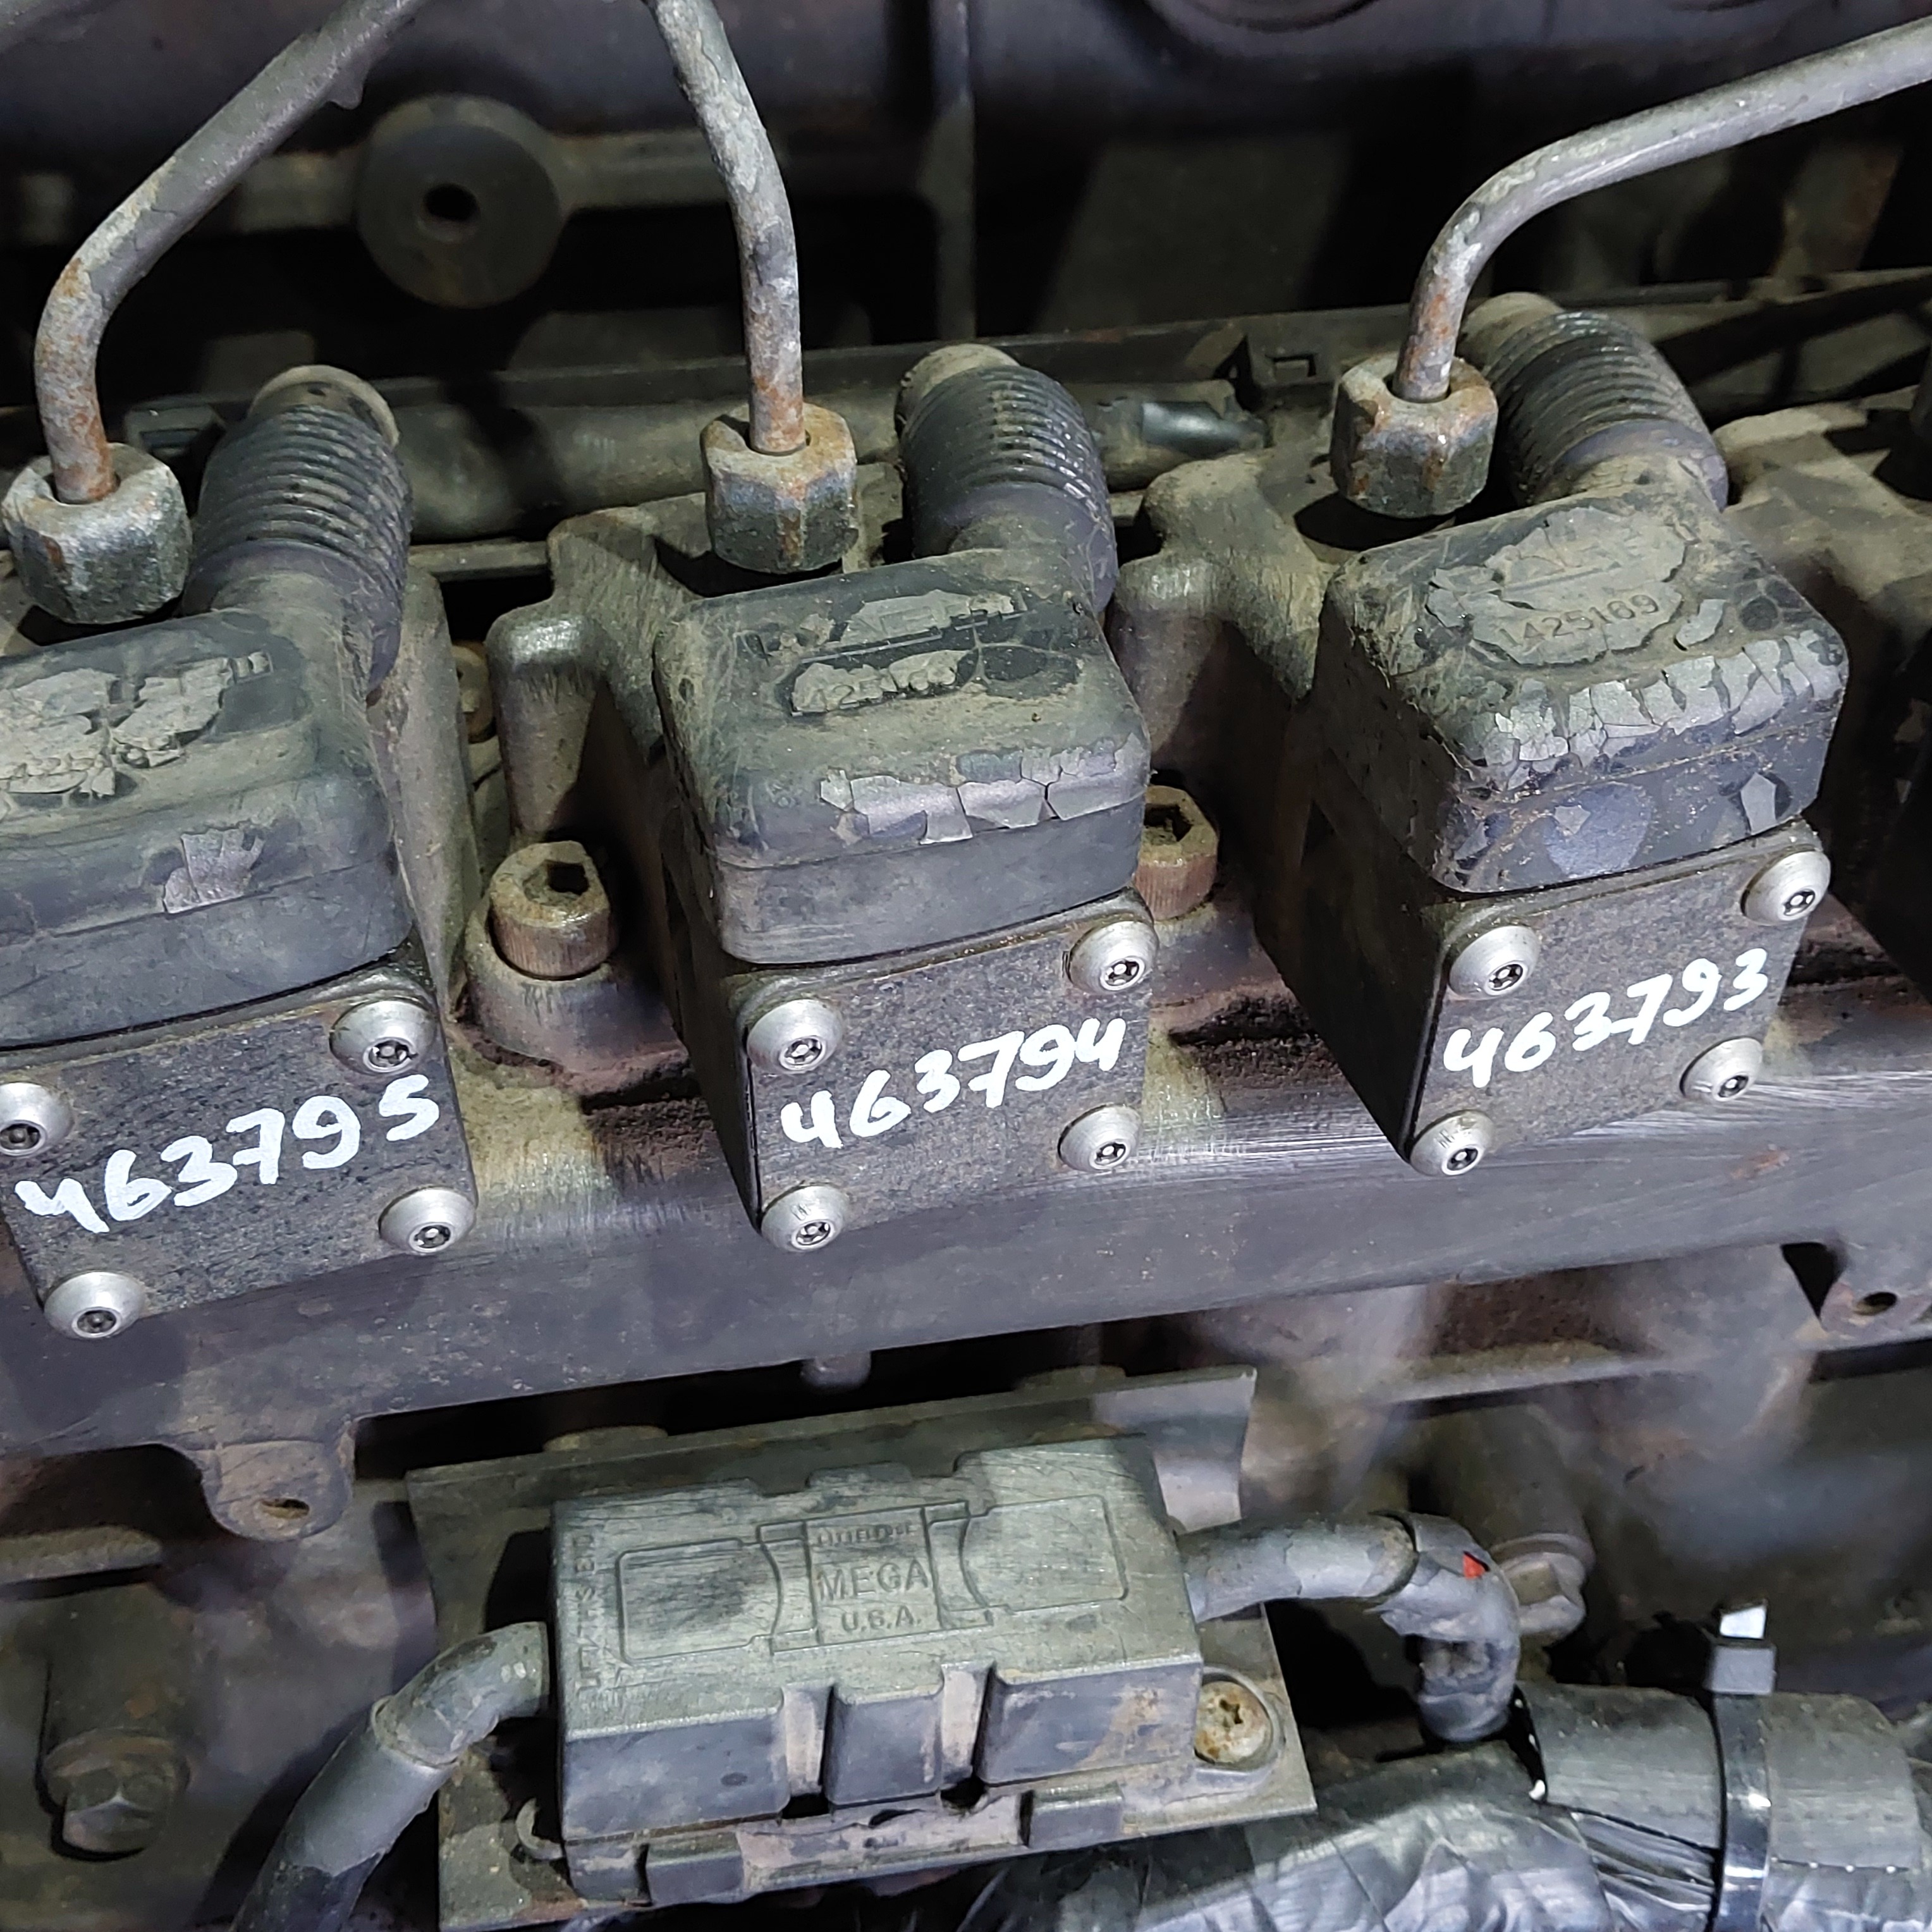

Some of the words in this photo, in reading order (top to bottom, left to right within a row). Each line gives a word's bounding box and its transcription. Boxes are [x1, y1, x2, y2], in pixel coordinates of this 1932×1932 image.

[780, 1017, 1126, 1149] 463794
[1443, 948, 1768, 1088] 463793
[15, 1074, 439, 1233] 463795
[817, 1559, 928, 1600] MEGA
